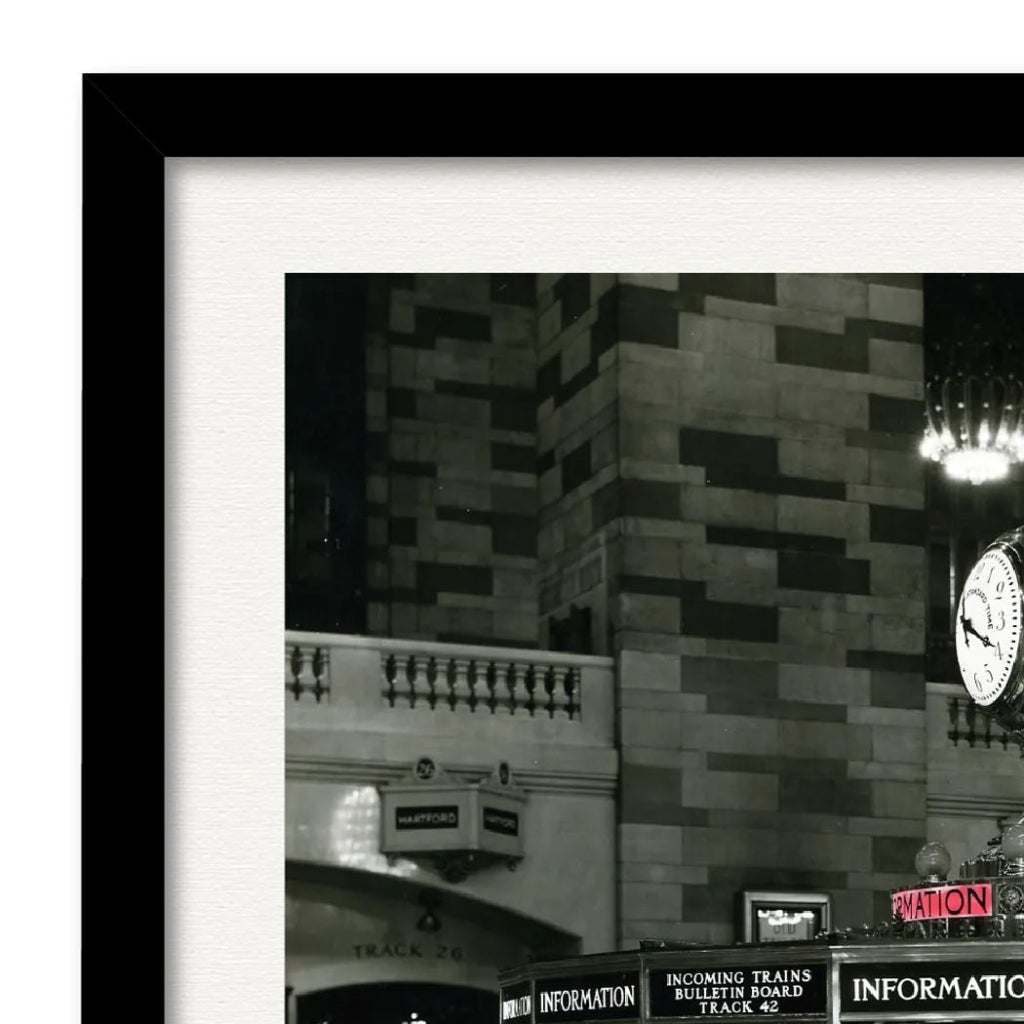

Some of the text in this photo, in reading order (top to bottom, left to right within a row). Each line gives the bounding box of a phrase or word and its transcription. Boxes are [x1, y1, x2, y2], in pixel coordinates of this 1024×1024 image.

[995, 610, 1006, 631] 3
[993, 641, 1004, 661] 4
[352, 943, 423, 959] TRACK
[667, 969, 811, 986] INCOMING TRAINS
[541, 985, 634, 1012] INFORMATION
[676, 985, 802, 1000] BULLETIN BOARD
[700, 1001, 778, 1013] TRACK 42
